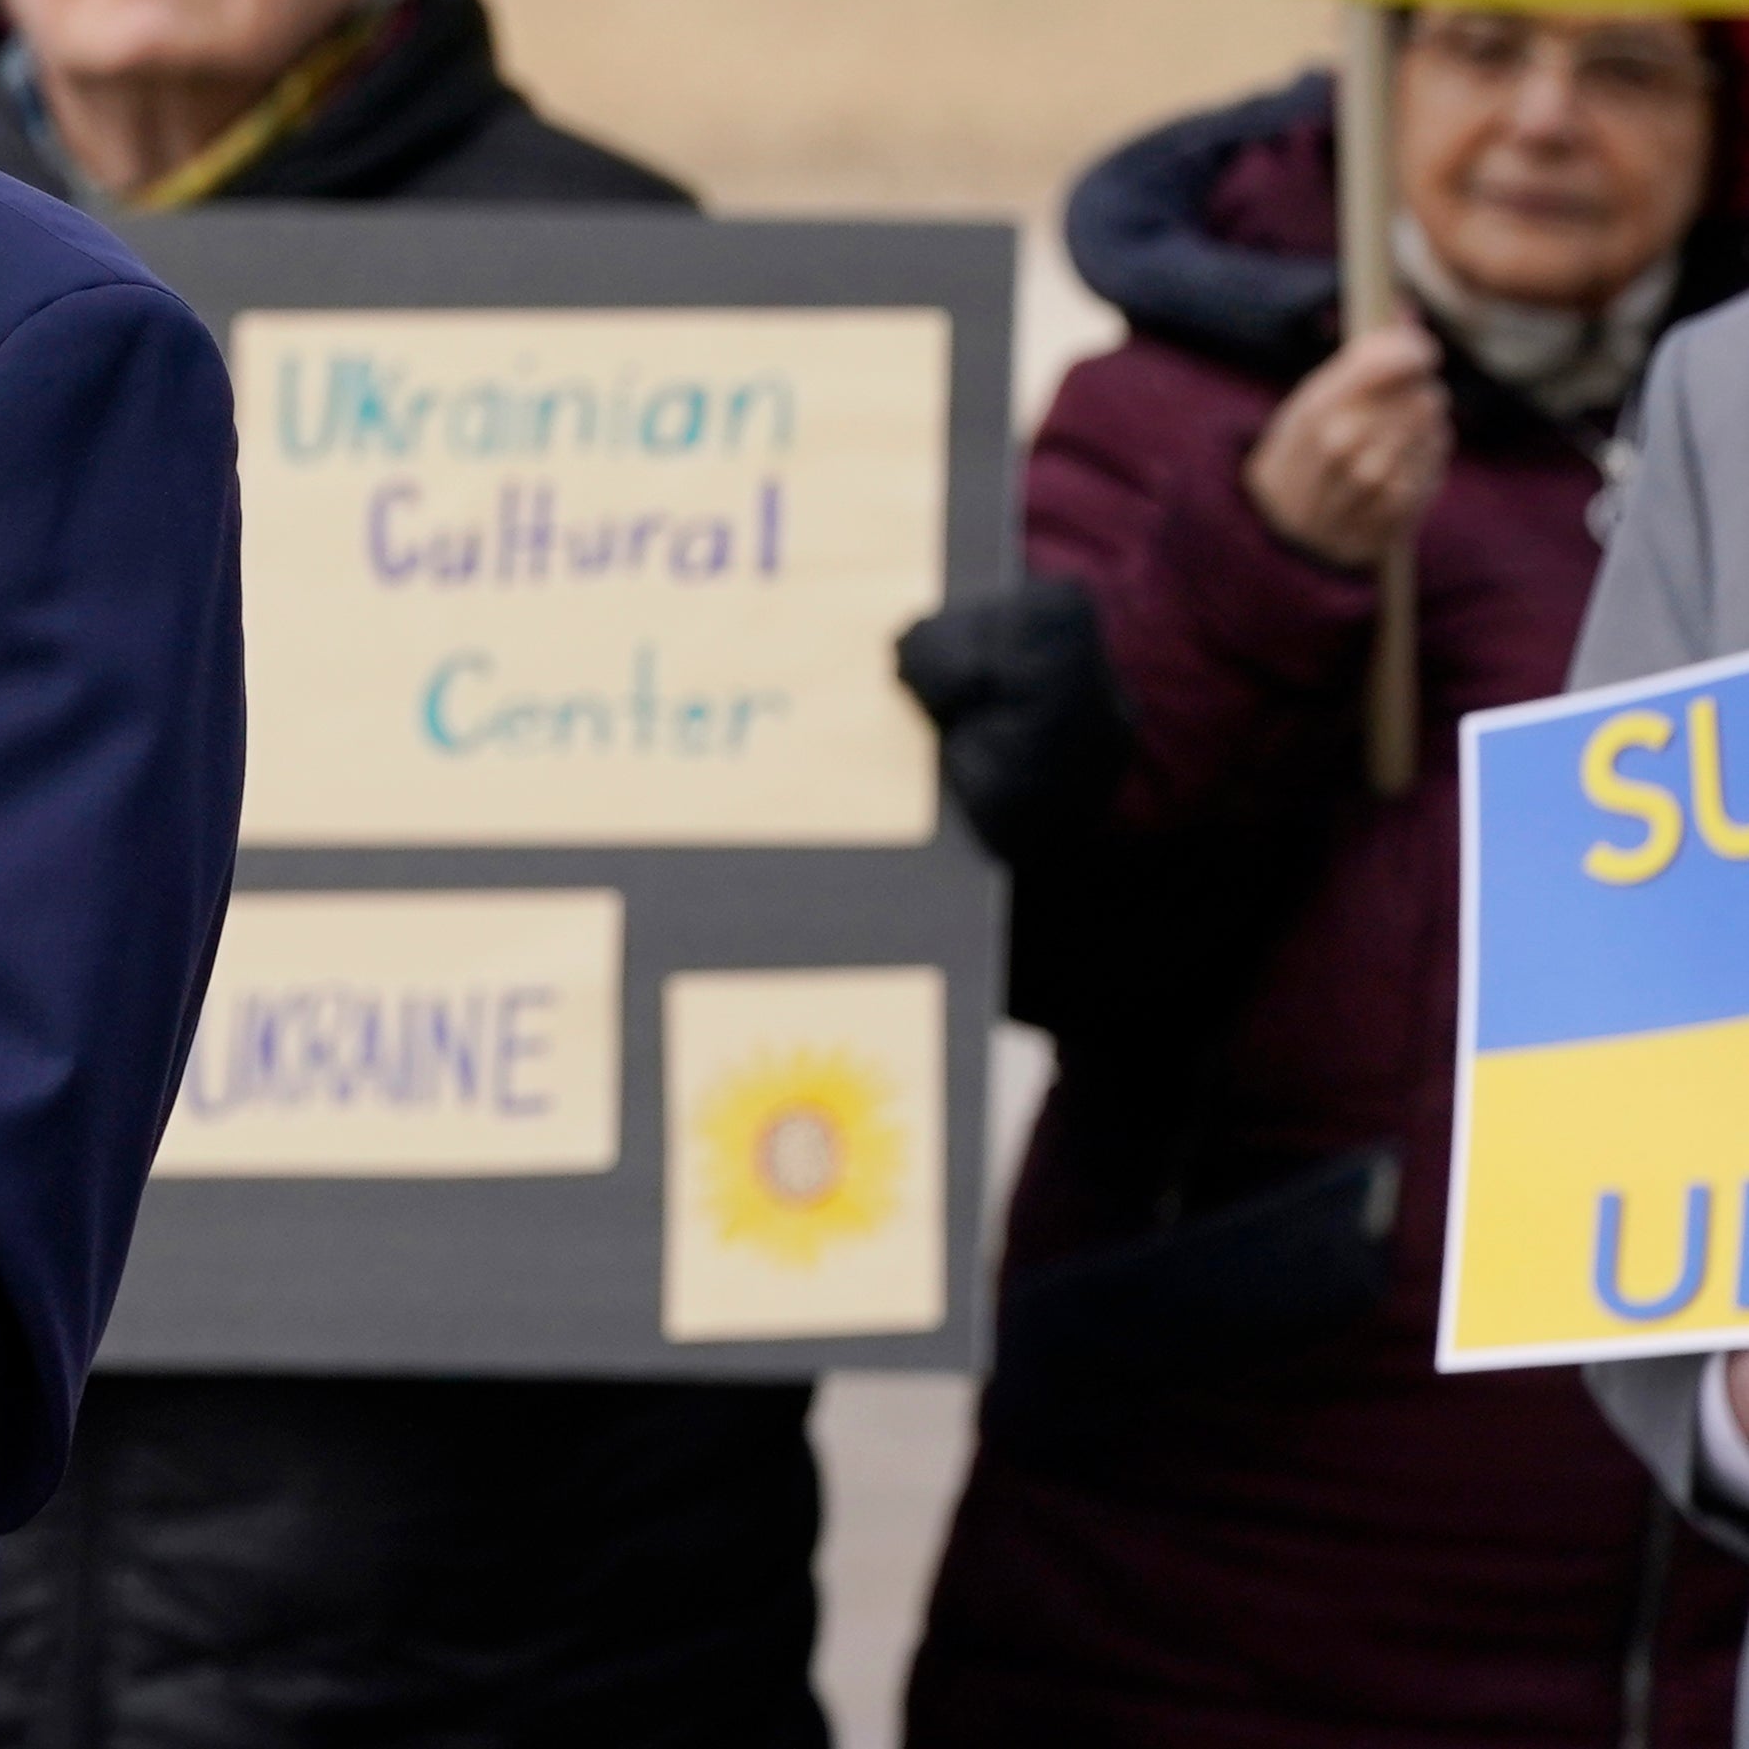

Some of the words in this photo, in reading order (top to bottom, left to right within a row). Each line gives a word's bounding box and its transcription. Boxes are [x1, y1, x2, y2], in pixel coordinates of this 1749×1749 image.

[367, 476, 781, 588] Cultural
[421, 638, 793, 764] Center
[187, 982, 563, 1122] UKRAINE
[1591, 1176, 1749, 1322] U
